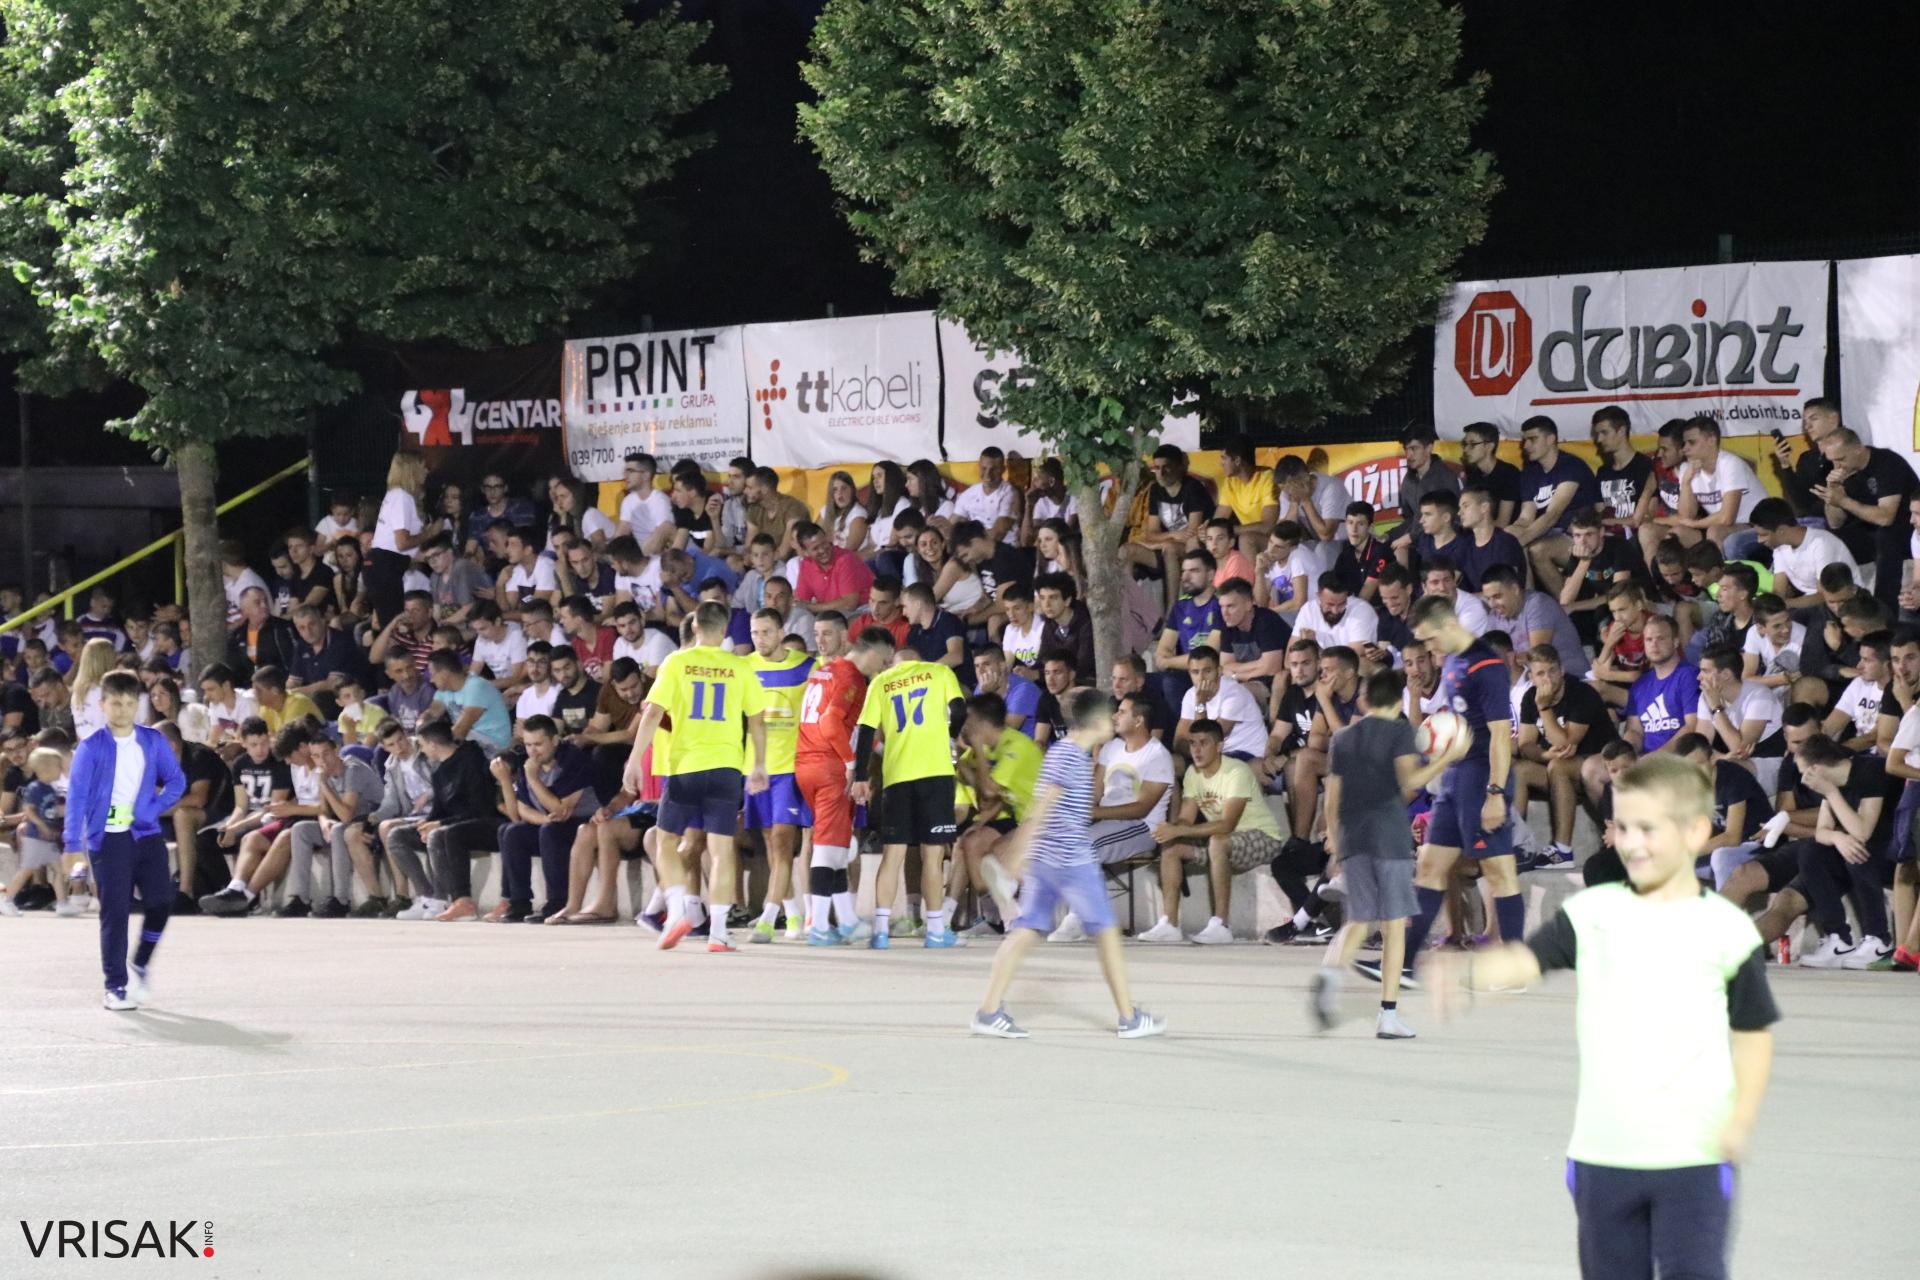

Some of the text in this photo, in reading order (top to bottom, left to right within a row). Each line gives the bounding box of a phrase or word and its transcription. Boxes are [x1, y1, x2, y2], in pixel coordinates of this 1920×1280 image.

[586, 336, 716, 400] PRINT
[680, 393, 716, 409] GRUPA
[796, 361, 921, 413] ttkabeli
[475, 399, 562, 430] CENTAR
[685, 665, 735, 678] DESETKA
[883, 672, 932, 693] DESETKA
[688, 681, 726, 721] 11
[891, 687, 928, 733] 17
